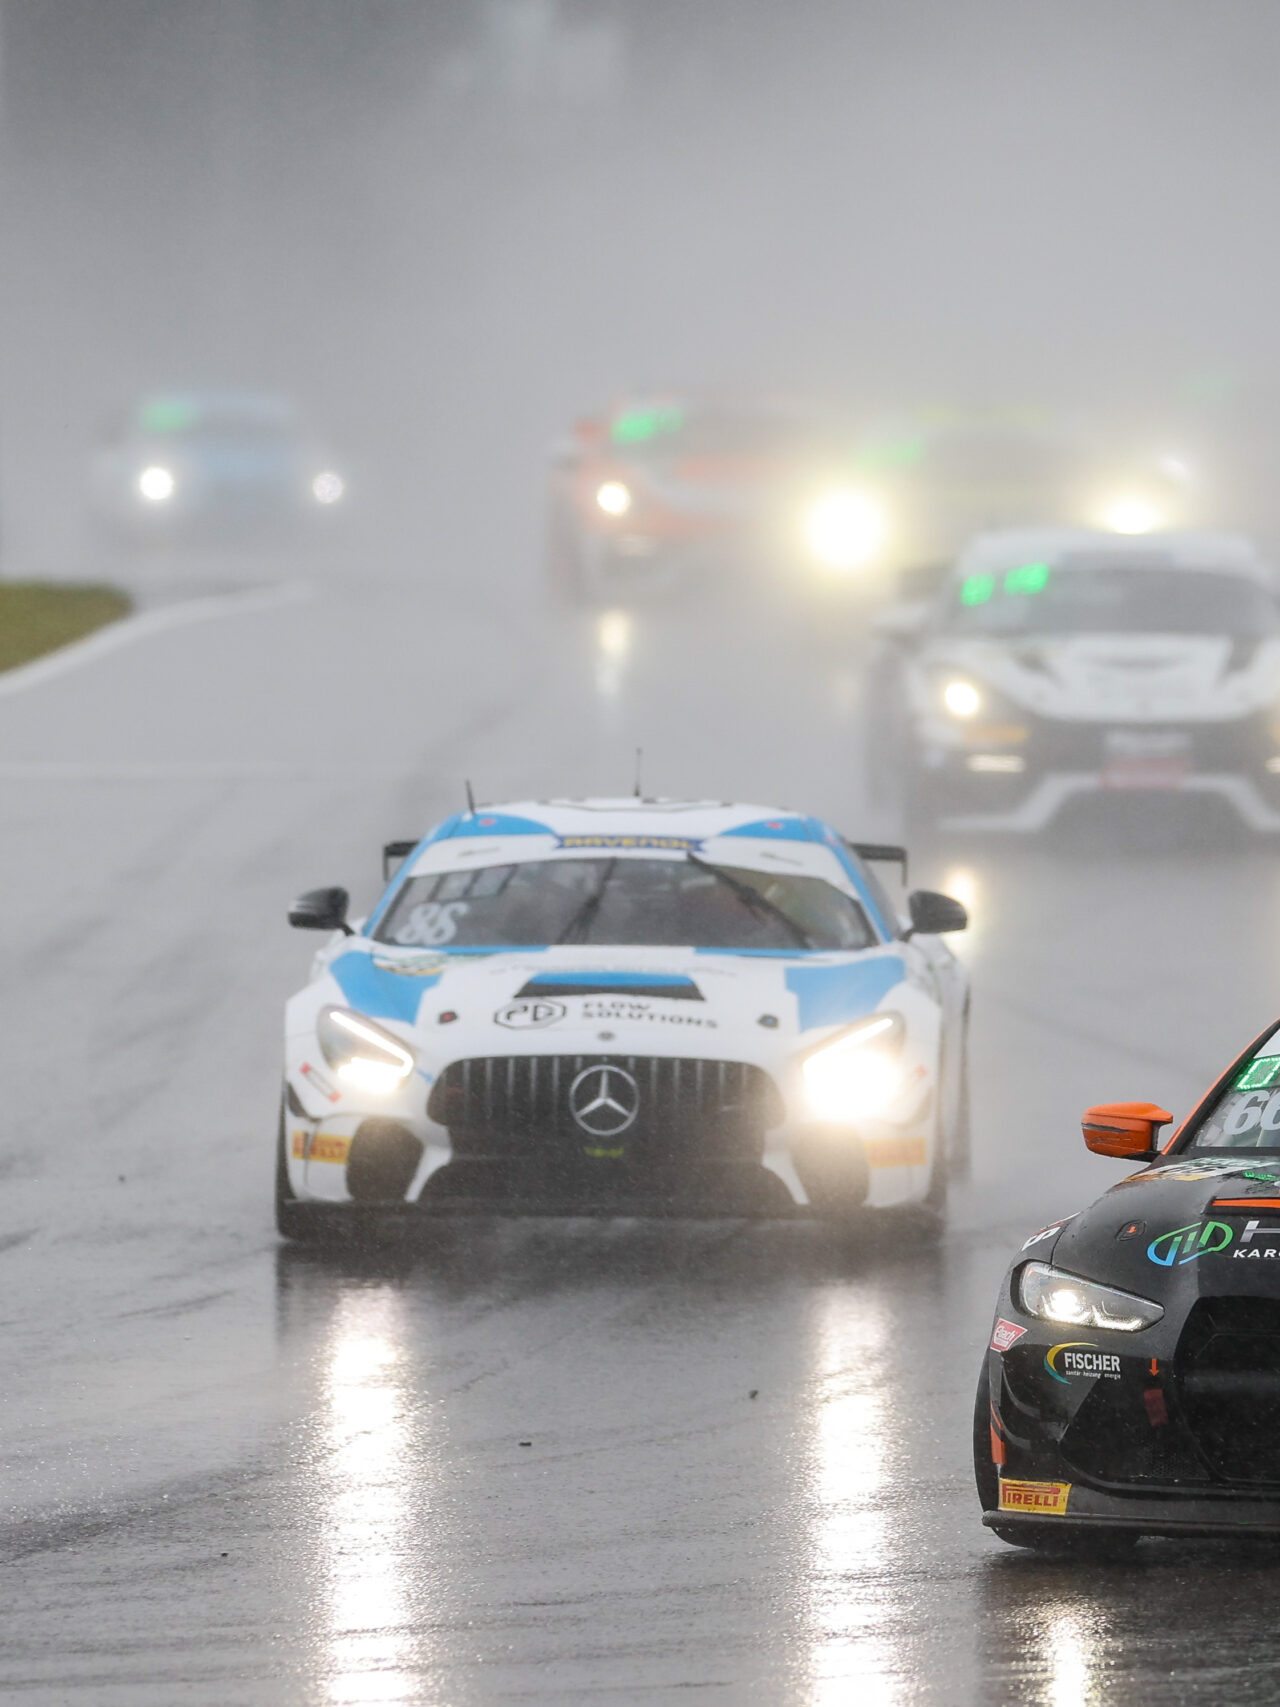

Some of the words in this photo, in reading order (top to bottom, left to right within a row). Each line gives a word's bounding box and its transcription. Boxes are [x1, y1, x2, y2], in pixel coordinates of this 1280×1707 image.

[582, 1011, 718, 1029] SOLUTIONS
[1063, 1352, 1121, 1372] FISCHER
[1002, 1483, 1061, 1507] PIRELLI
